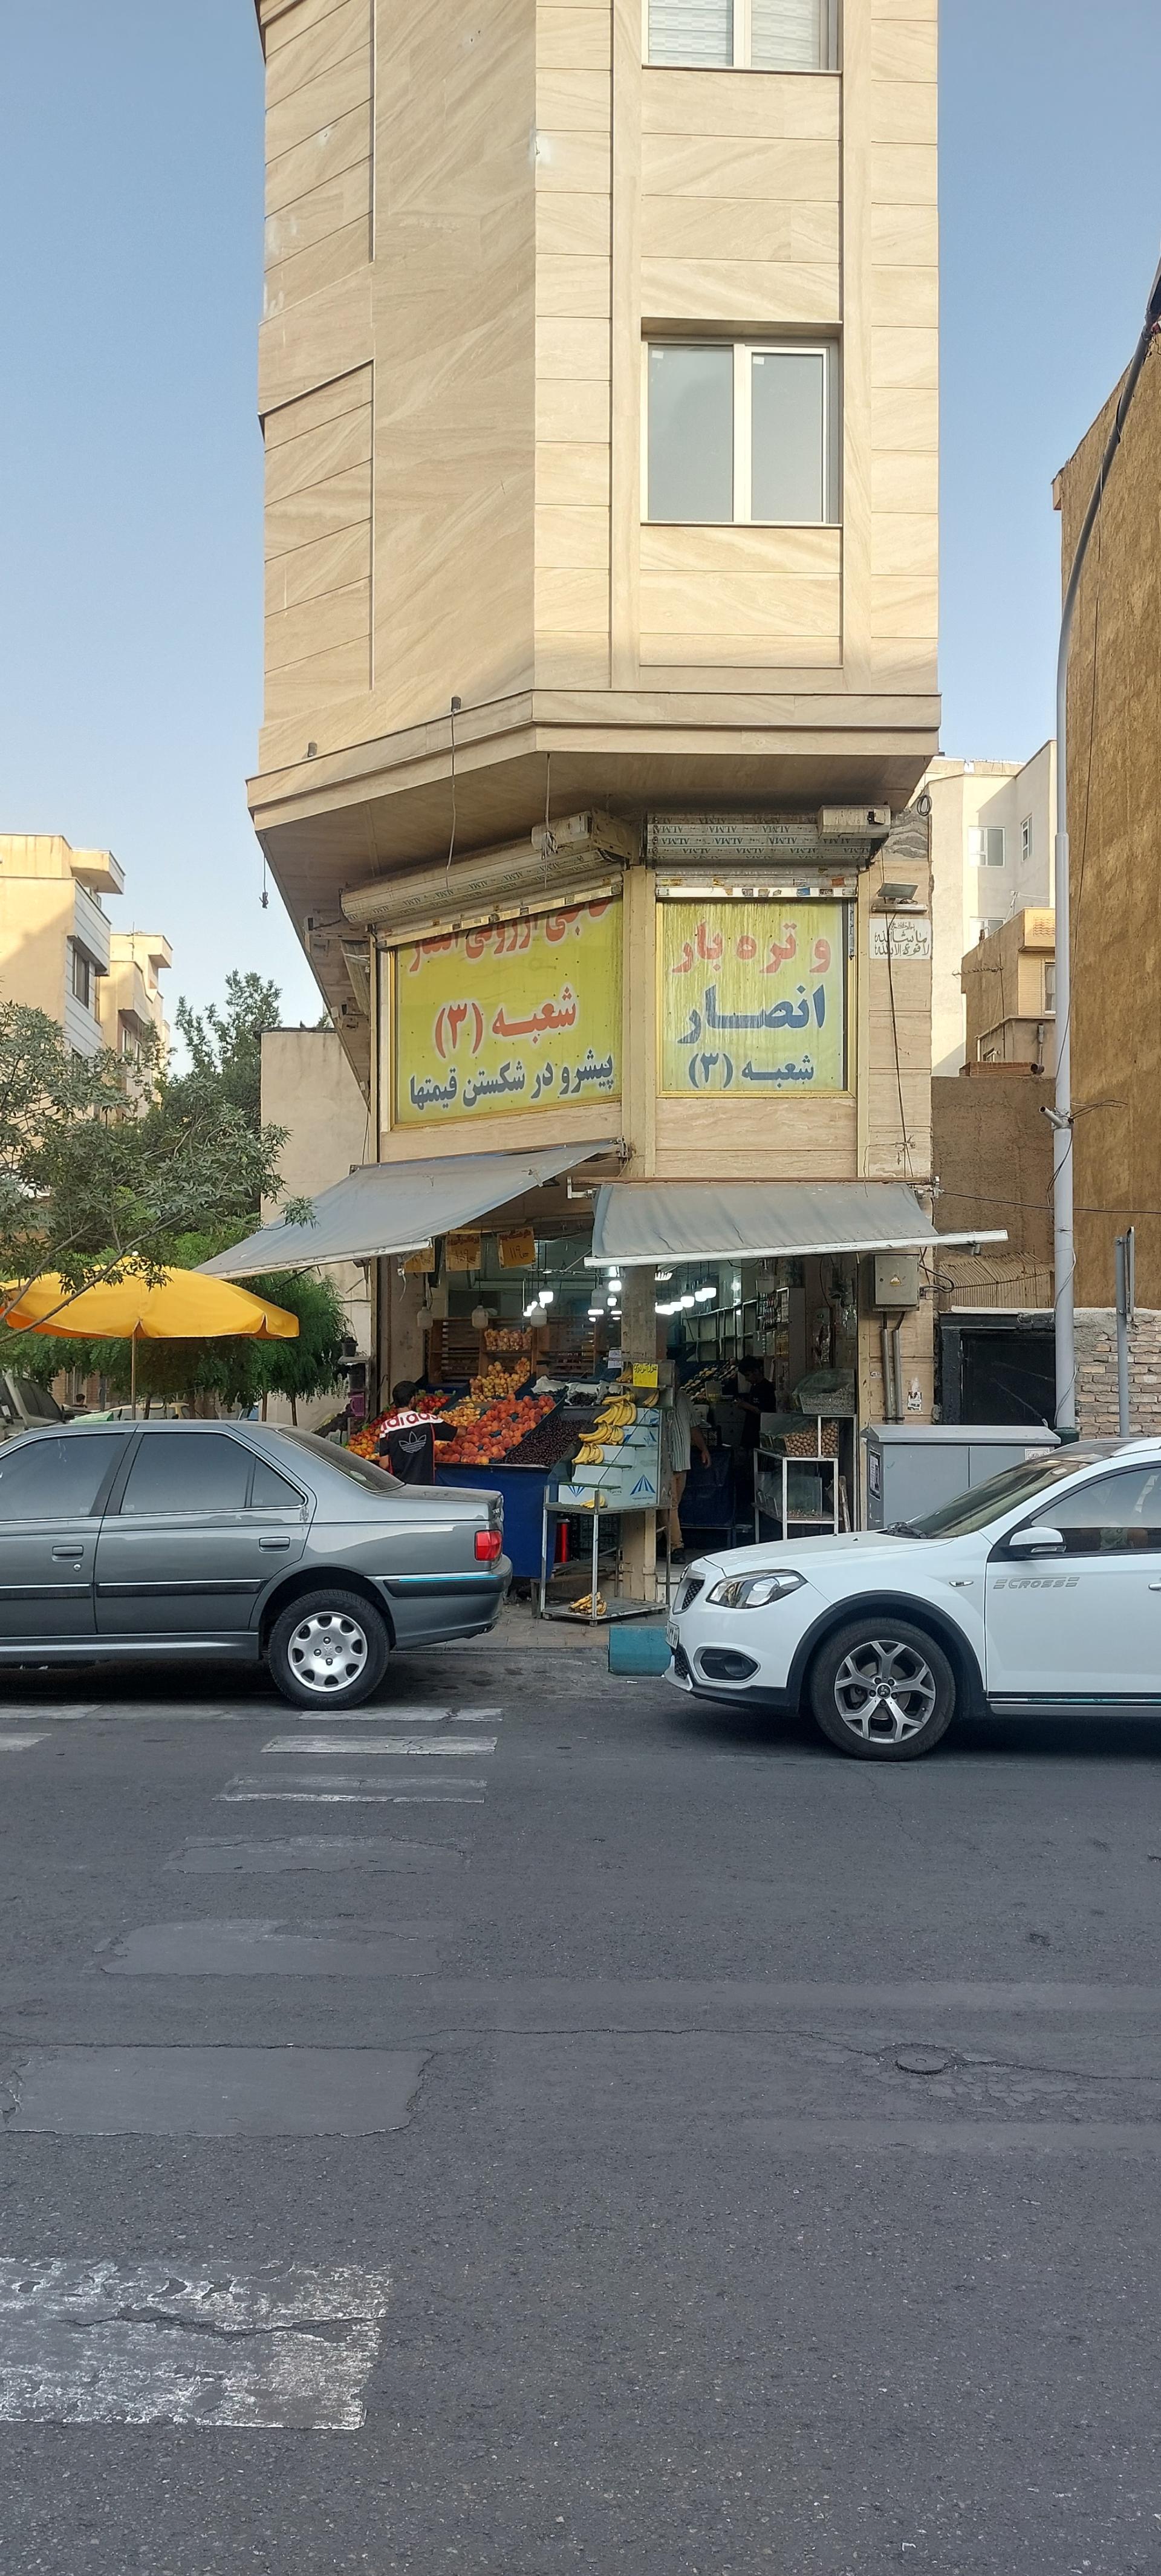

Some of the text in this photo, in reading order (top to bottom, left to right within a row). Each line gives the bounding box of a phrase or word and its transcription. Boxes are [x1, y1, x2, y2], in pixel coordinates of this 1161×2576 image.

[672, 919, 723, 974] بار
[735, 922, 797, 974] تره
[809, 937, 830, 973] و
[492, 986, 577, 1044] شعبه
[677, 983, 827, 1044] انصار
[410, 1049, 614, 1110] پیشرو در شکستن قیمتها
[741, 1054, 815, 1088] شعبه
